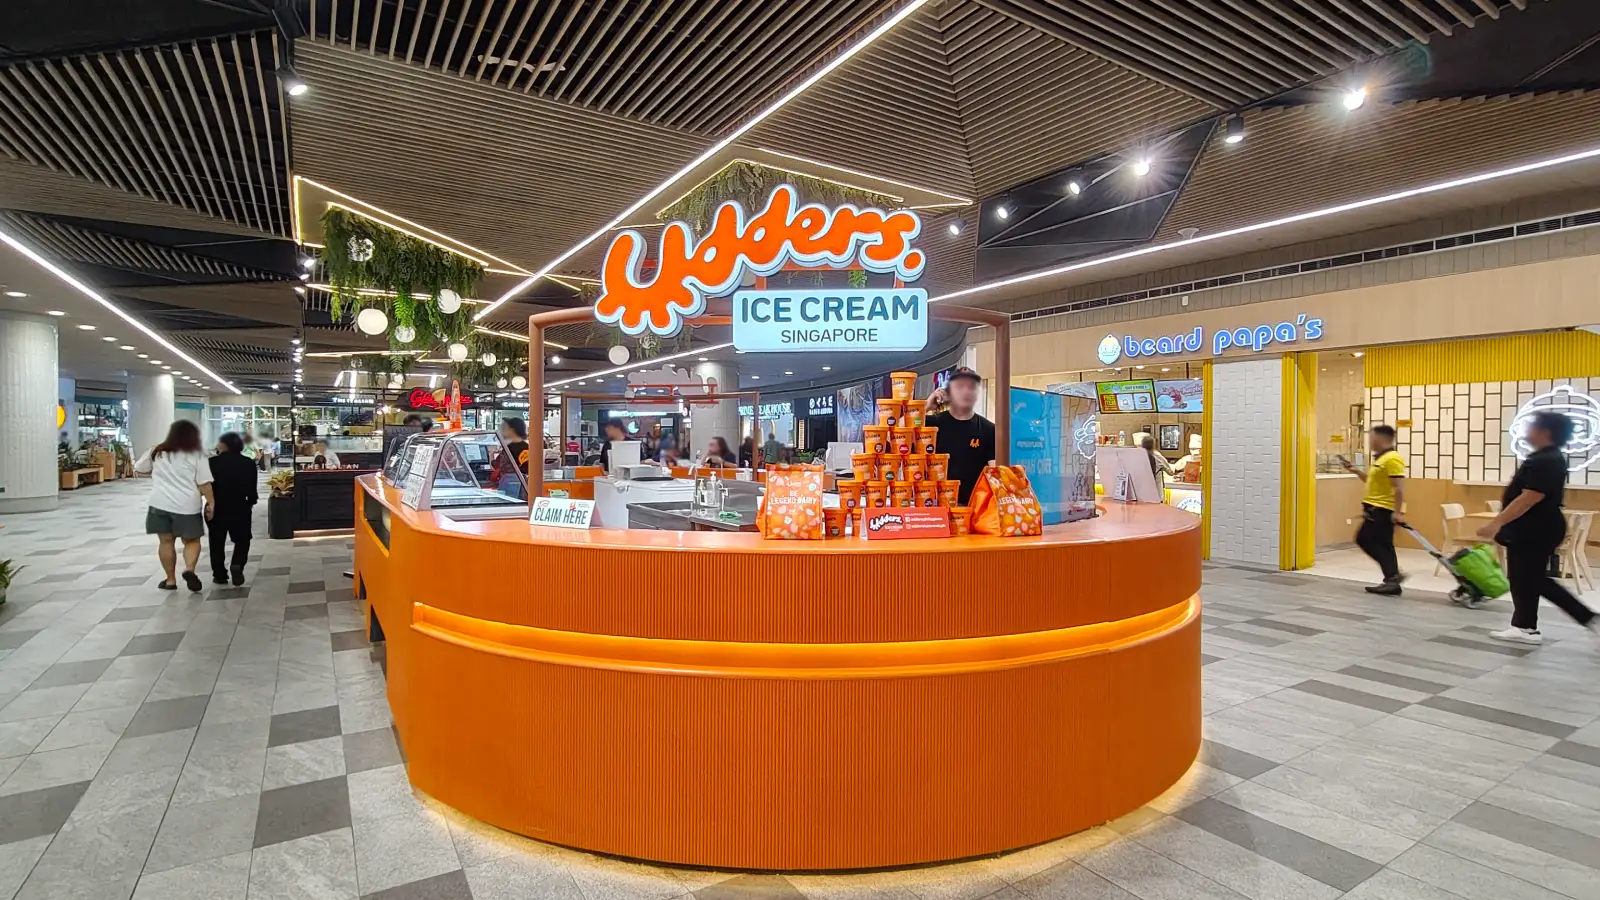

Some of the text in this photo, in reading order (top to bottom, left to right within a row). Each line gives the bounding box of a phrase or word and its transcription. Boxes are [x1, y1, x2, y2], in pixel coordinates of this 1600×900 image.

[740, 294, 919, 323] ICE CREAM
[780, 328, 879, 343] SINGAPORE
[1124, 314, 1322, 357] beard papa's
[534, 507, 588, 525] CLAIM HERE
